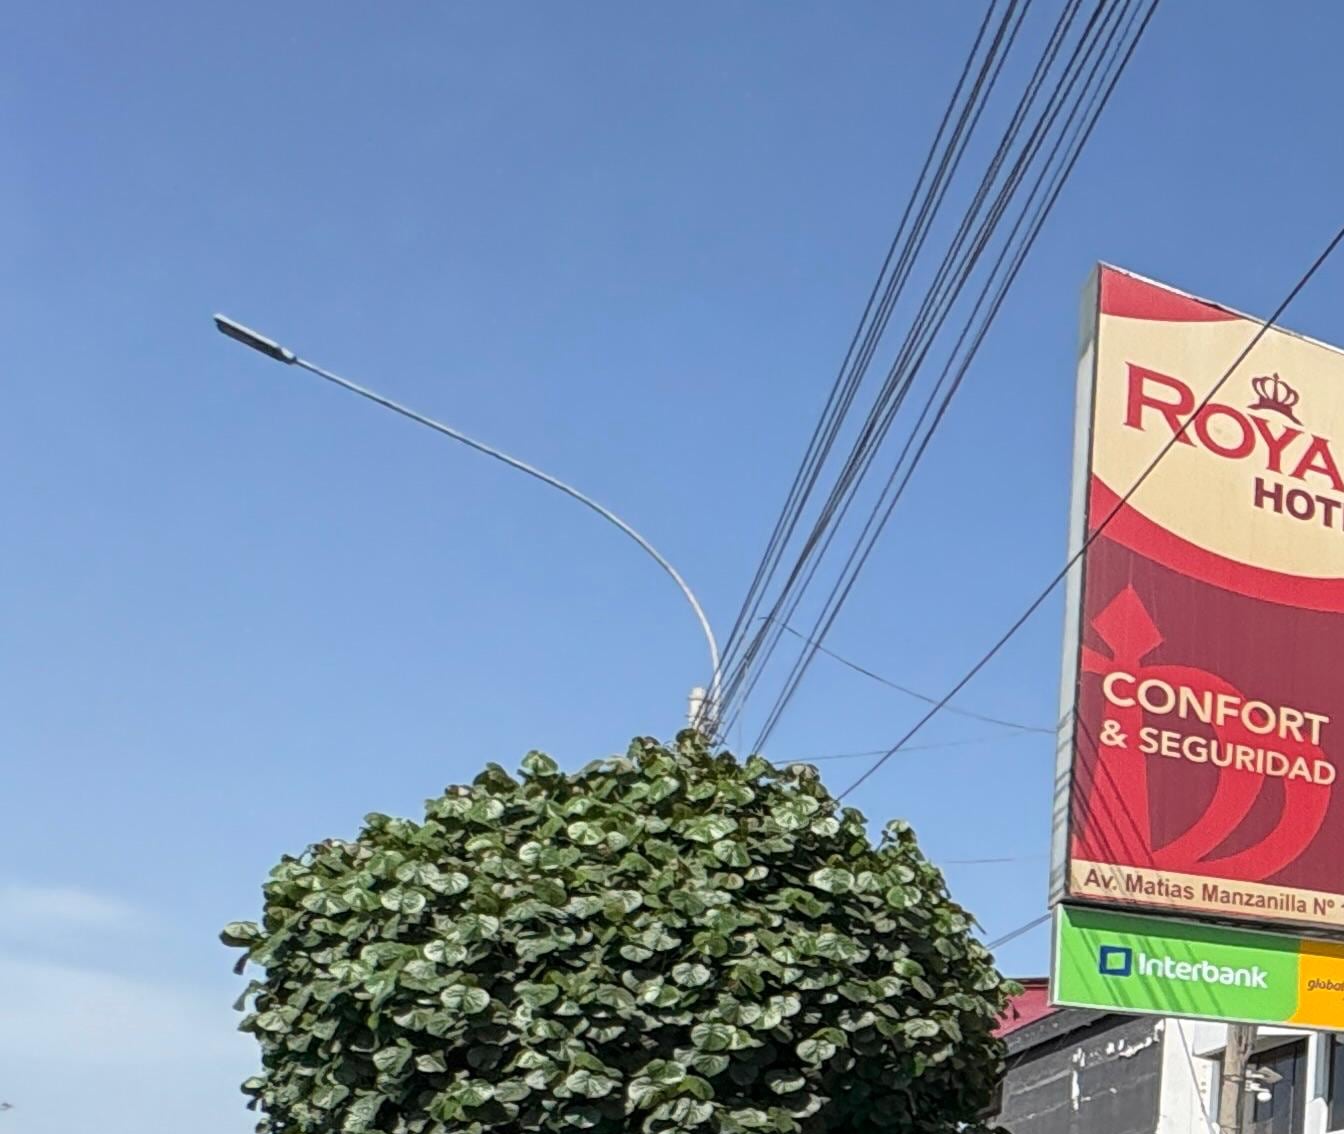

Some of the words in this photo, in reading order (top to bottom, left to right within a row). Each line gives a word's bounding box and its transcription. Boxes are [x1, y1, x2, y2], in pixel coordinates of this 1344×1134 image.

[1103, 671, 1330, 746] CONFORT
[1099, 719, 1128, 749] &
[1138, 726, 1336, 785] SEGURIDAD
[1084, 868, 1117, 891] Av.
[1125, 873, 1195, 901] Matias
[1202, 883, 1307, 914] Manzanilla
[1138, 951, 1268, 990] Interbank
